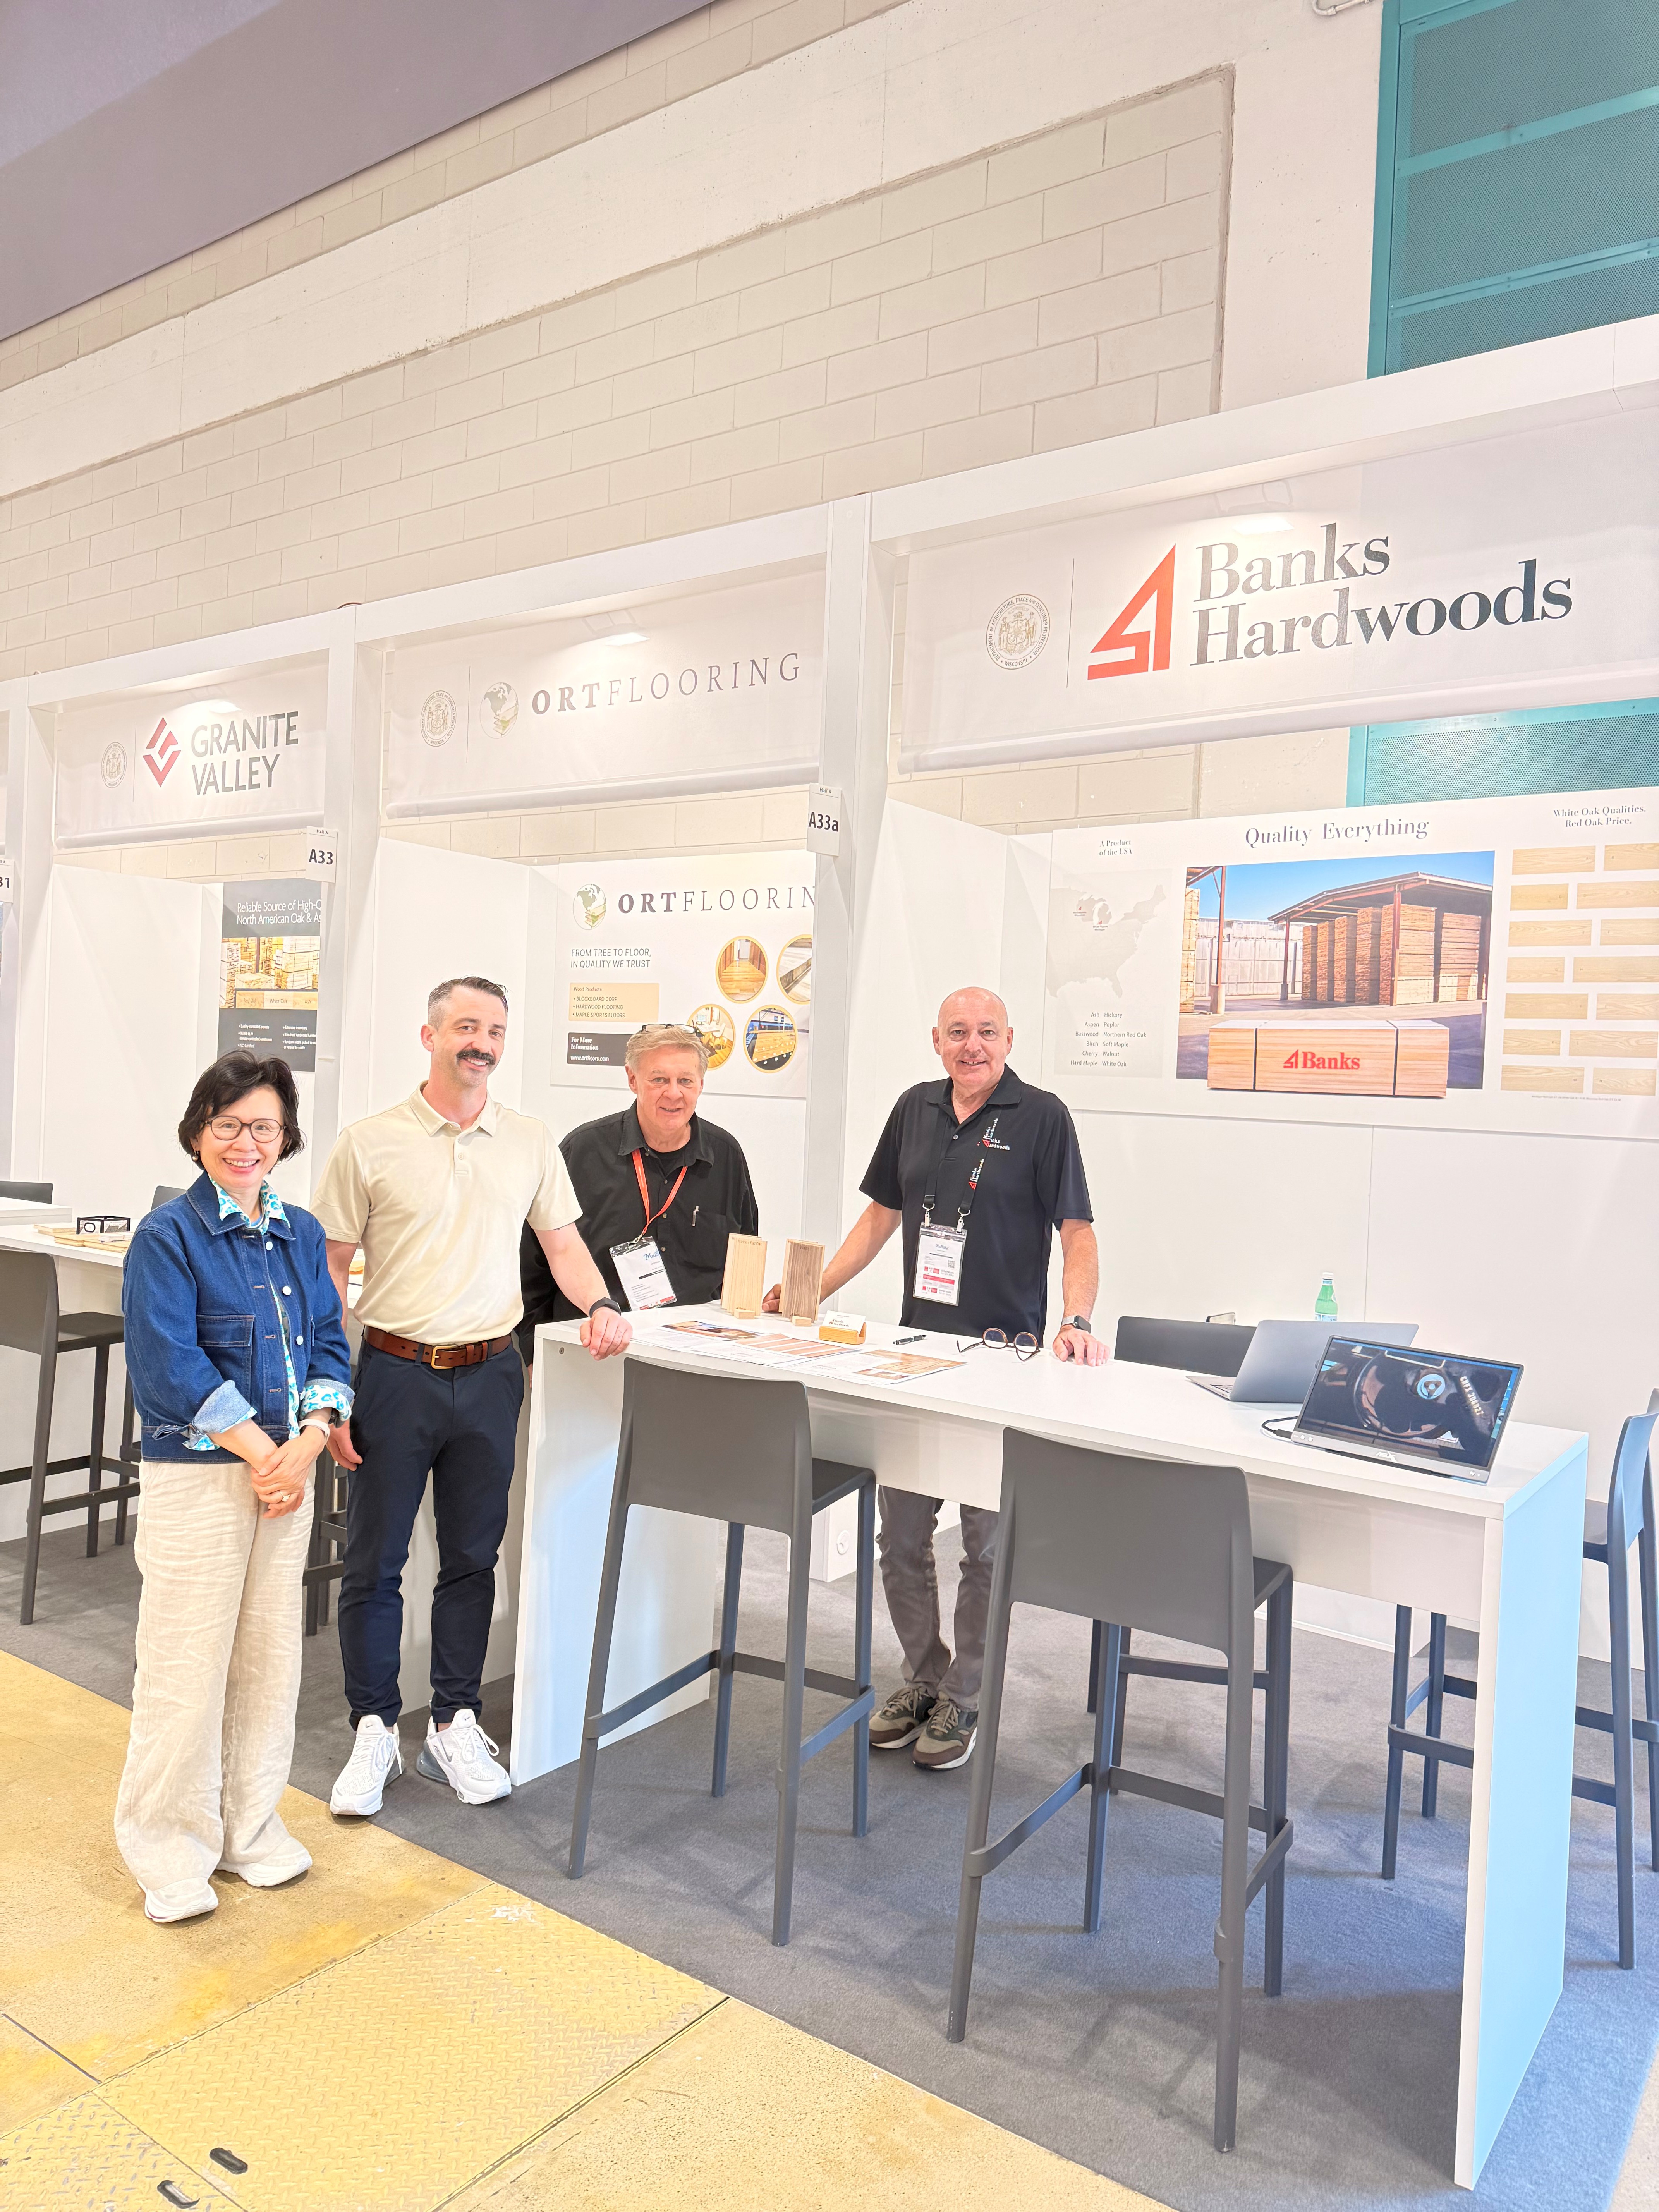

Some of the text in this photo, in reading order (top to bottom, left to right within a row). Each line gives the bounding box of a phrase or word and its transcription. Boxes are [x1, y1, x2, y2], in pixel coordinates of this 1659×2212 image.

[1194, 522, 1390, 602] Banks
[1190, 558, 1572, 666] Hardwoods
[191, 711, 298, 757] GRANITE
[192, 754, 280, 795] VALLEY
[1602, 805, 1646, 816] Qualities.
[809, 812, 838, 832] A33a
[1566, 819, 1582, 827] Red
[1245, 819, 1429, 848] Quality Everything
[309, 849, 333, 865] A33
[237, 902, 262, 912] Reliable
[263, 902, 286, 912] Source
[288, 899, 296, 911] of
[237, 914, 256, 925] North
[258, 914, 289, 924] American
[291, 912, 305, 923] Oak
[306, 913, 312, 923] &
[625, 948, 651, 957] FLOOR,
[1302, 1051, 1360, 1070] Banks
